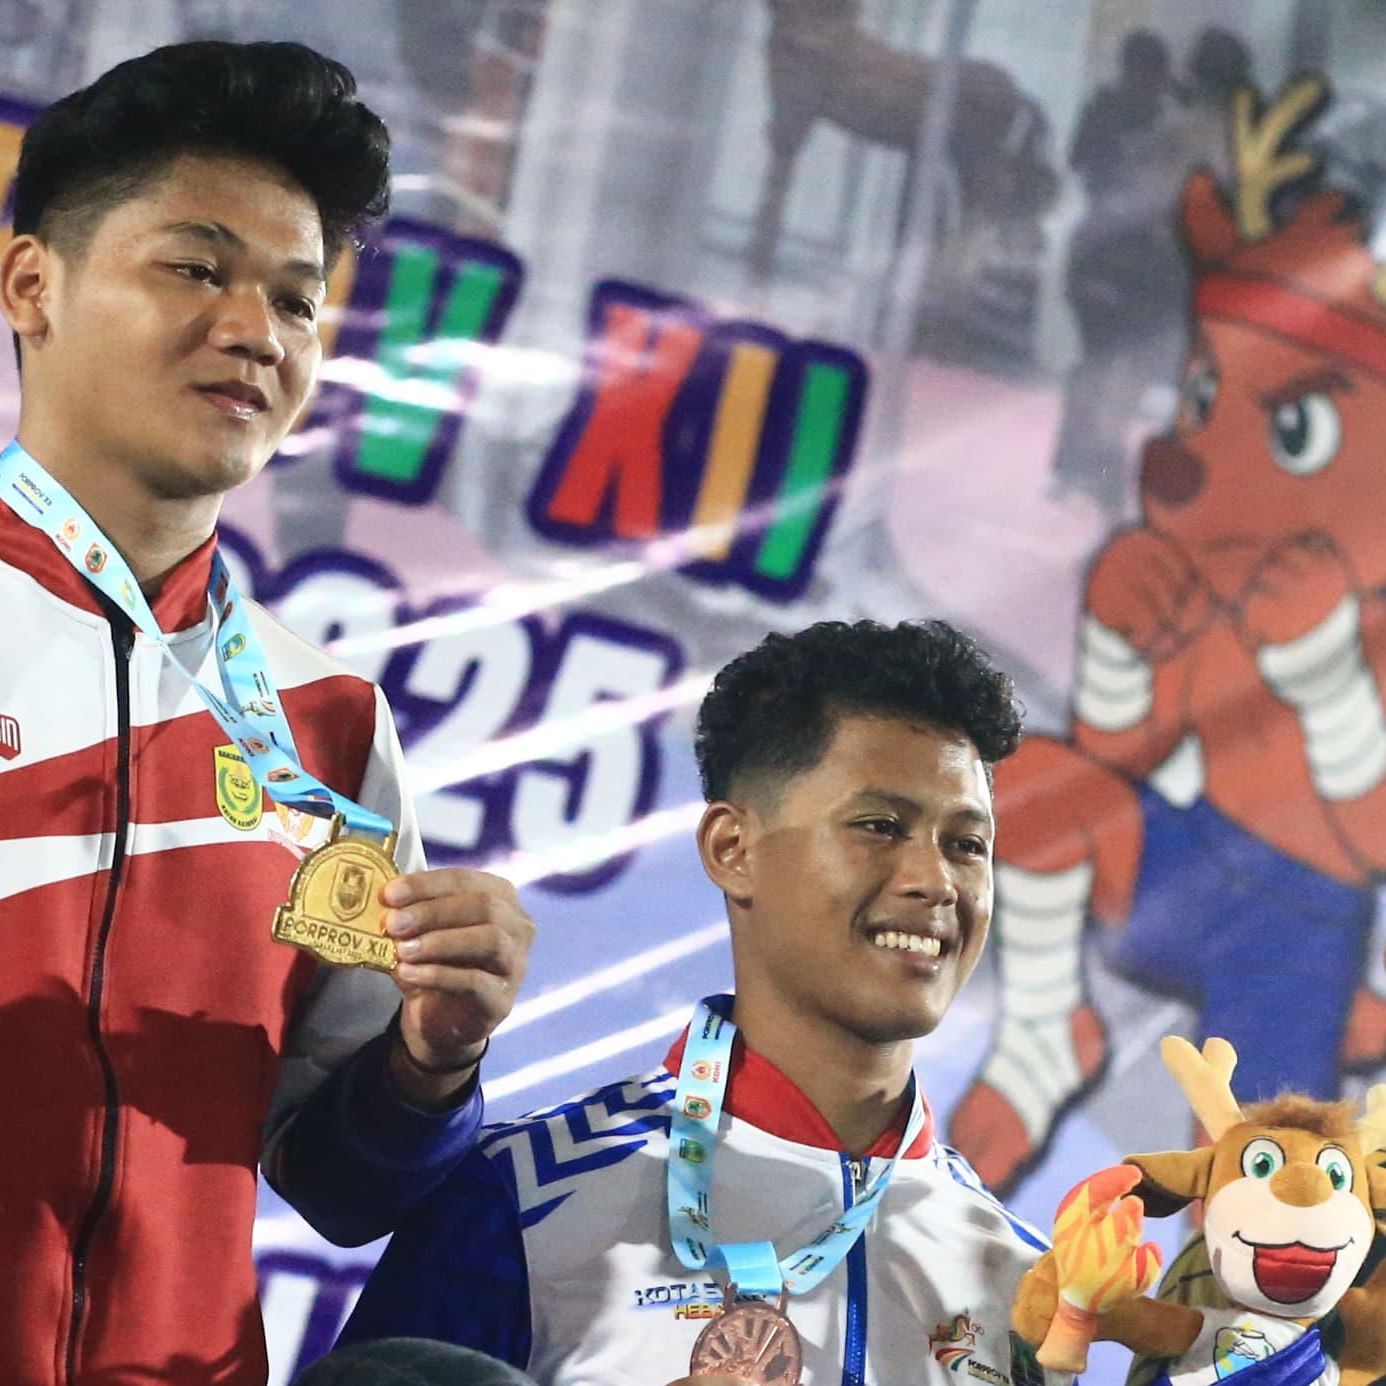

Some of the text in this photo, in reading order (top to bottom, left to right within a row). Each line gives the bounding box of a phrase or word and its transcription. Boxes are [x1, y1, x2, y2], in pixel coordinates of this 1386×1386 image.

[546, 303, 851, 581] XII
[284, 916, 363, 950] PORPROV
[368, 939, 389, 958] XII
